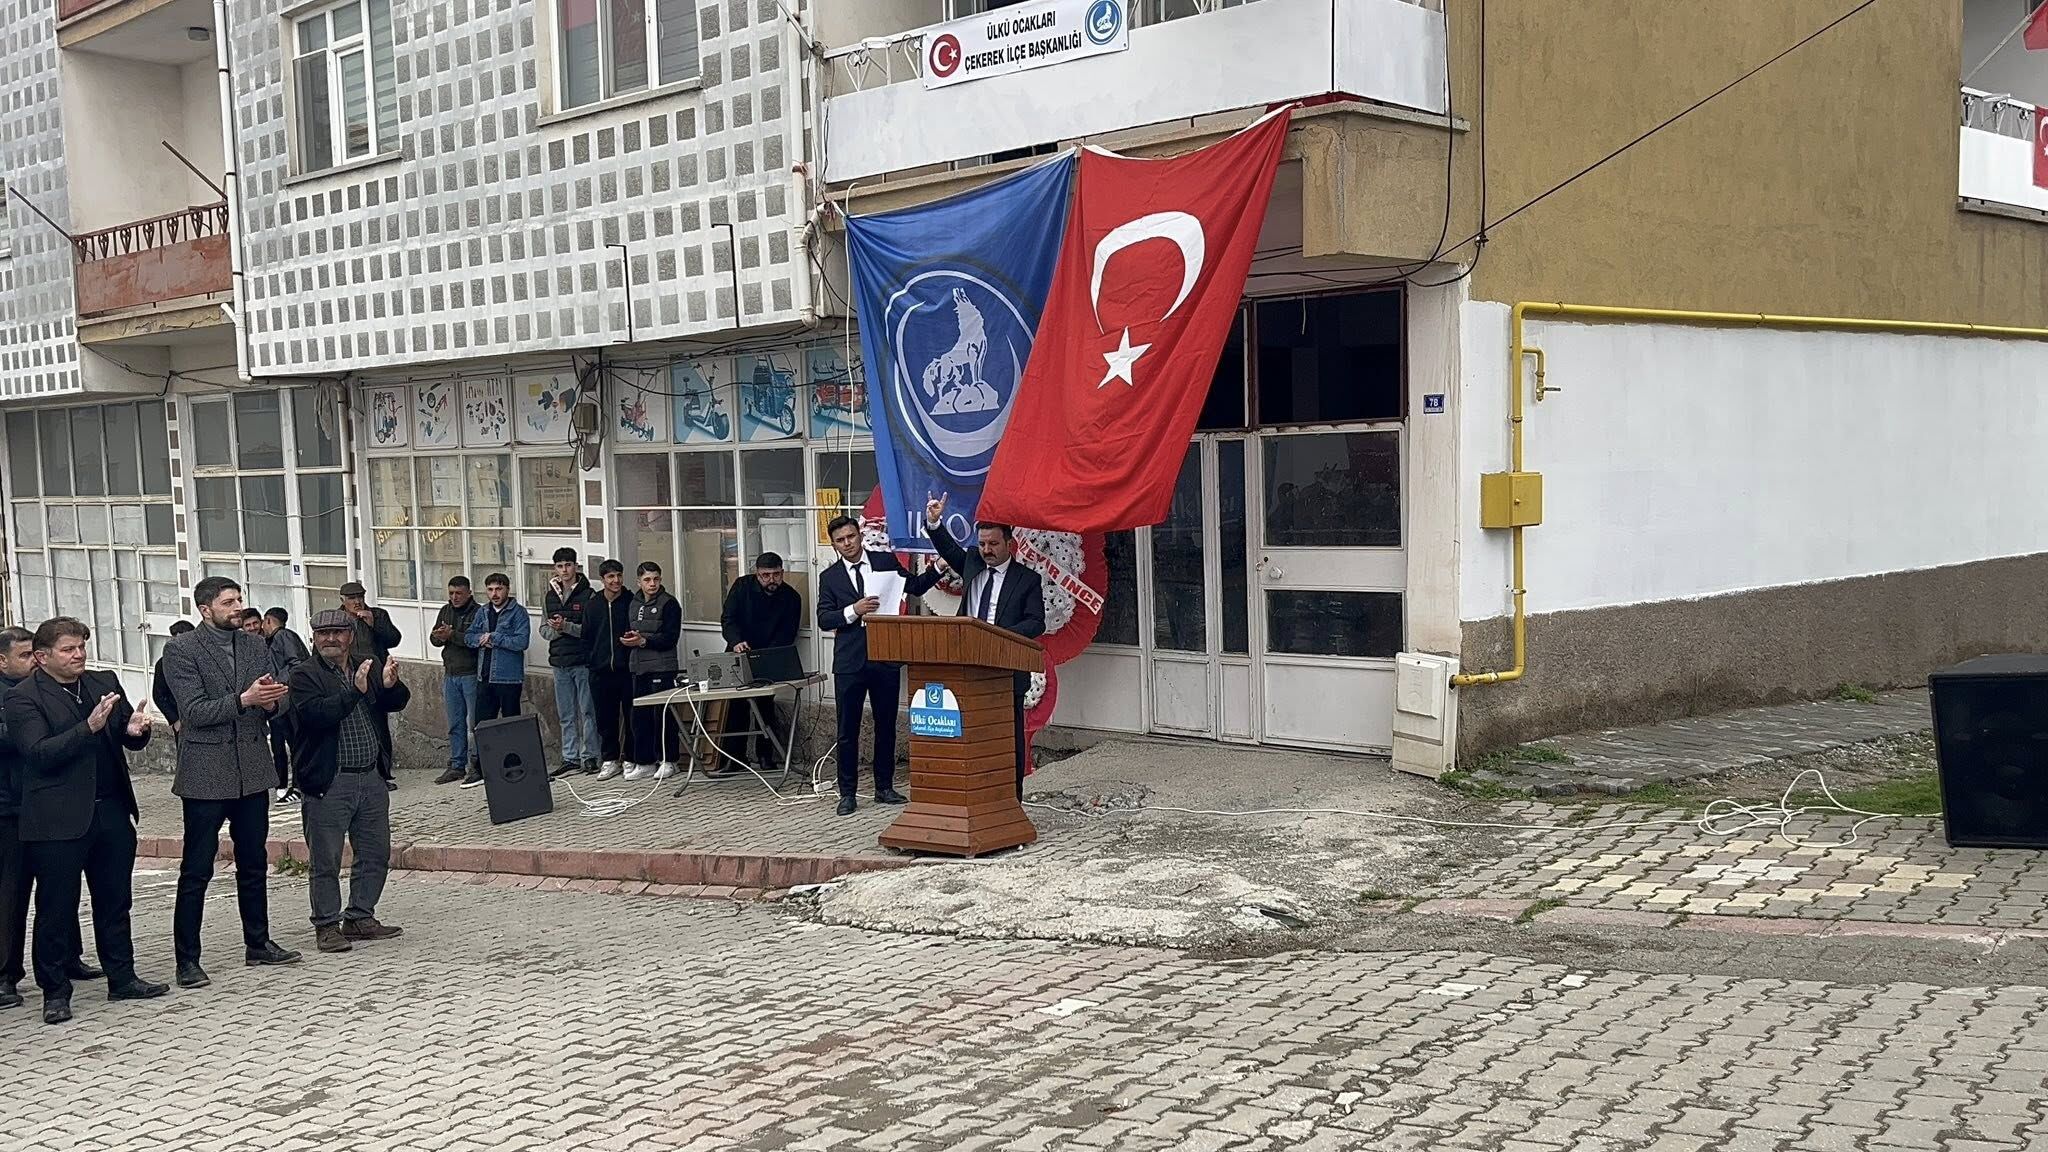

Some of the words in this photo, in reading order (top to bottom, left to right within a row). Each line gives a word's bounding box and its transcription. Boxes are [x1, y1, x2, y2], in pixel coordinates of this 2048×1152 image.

[987, 18, 1010, 40] ÜLKÜ
[1012, 11, 1056, 35] OCAKLARI
[964, 50, 1004, 74] ÇEKEREK
[1007, 44, 1026, 64] İLÇE
[1029, 29, 1082, 60] BAŞKANLIĞI
